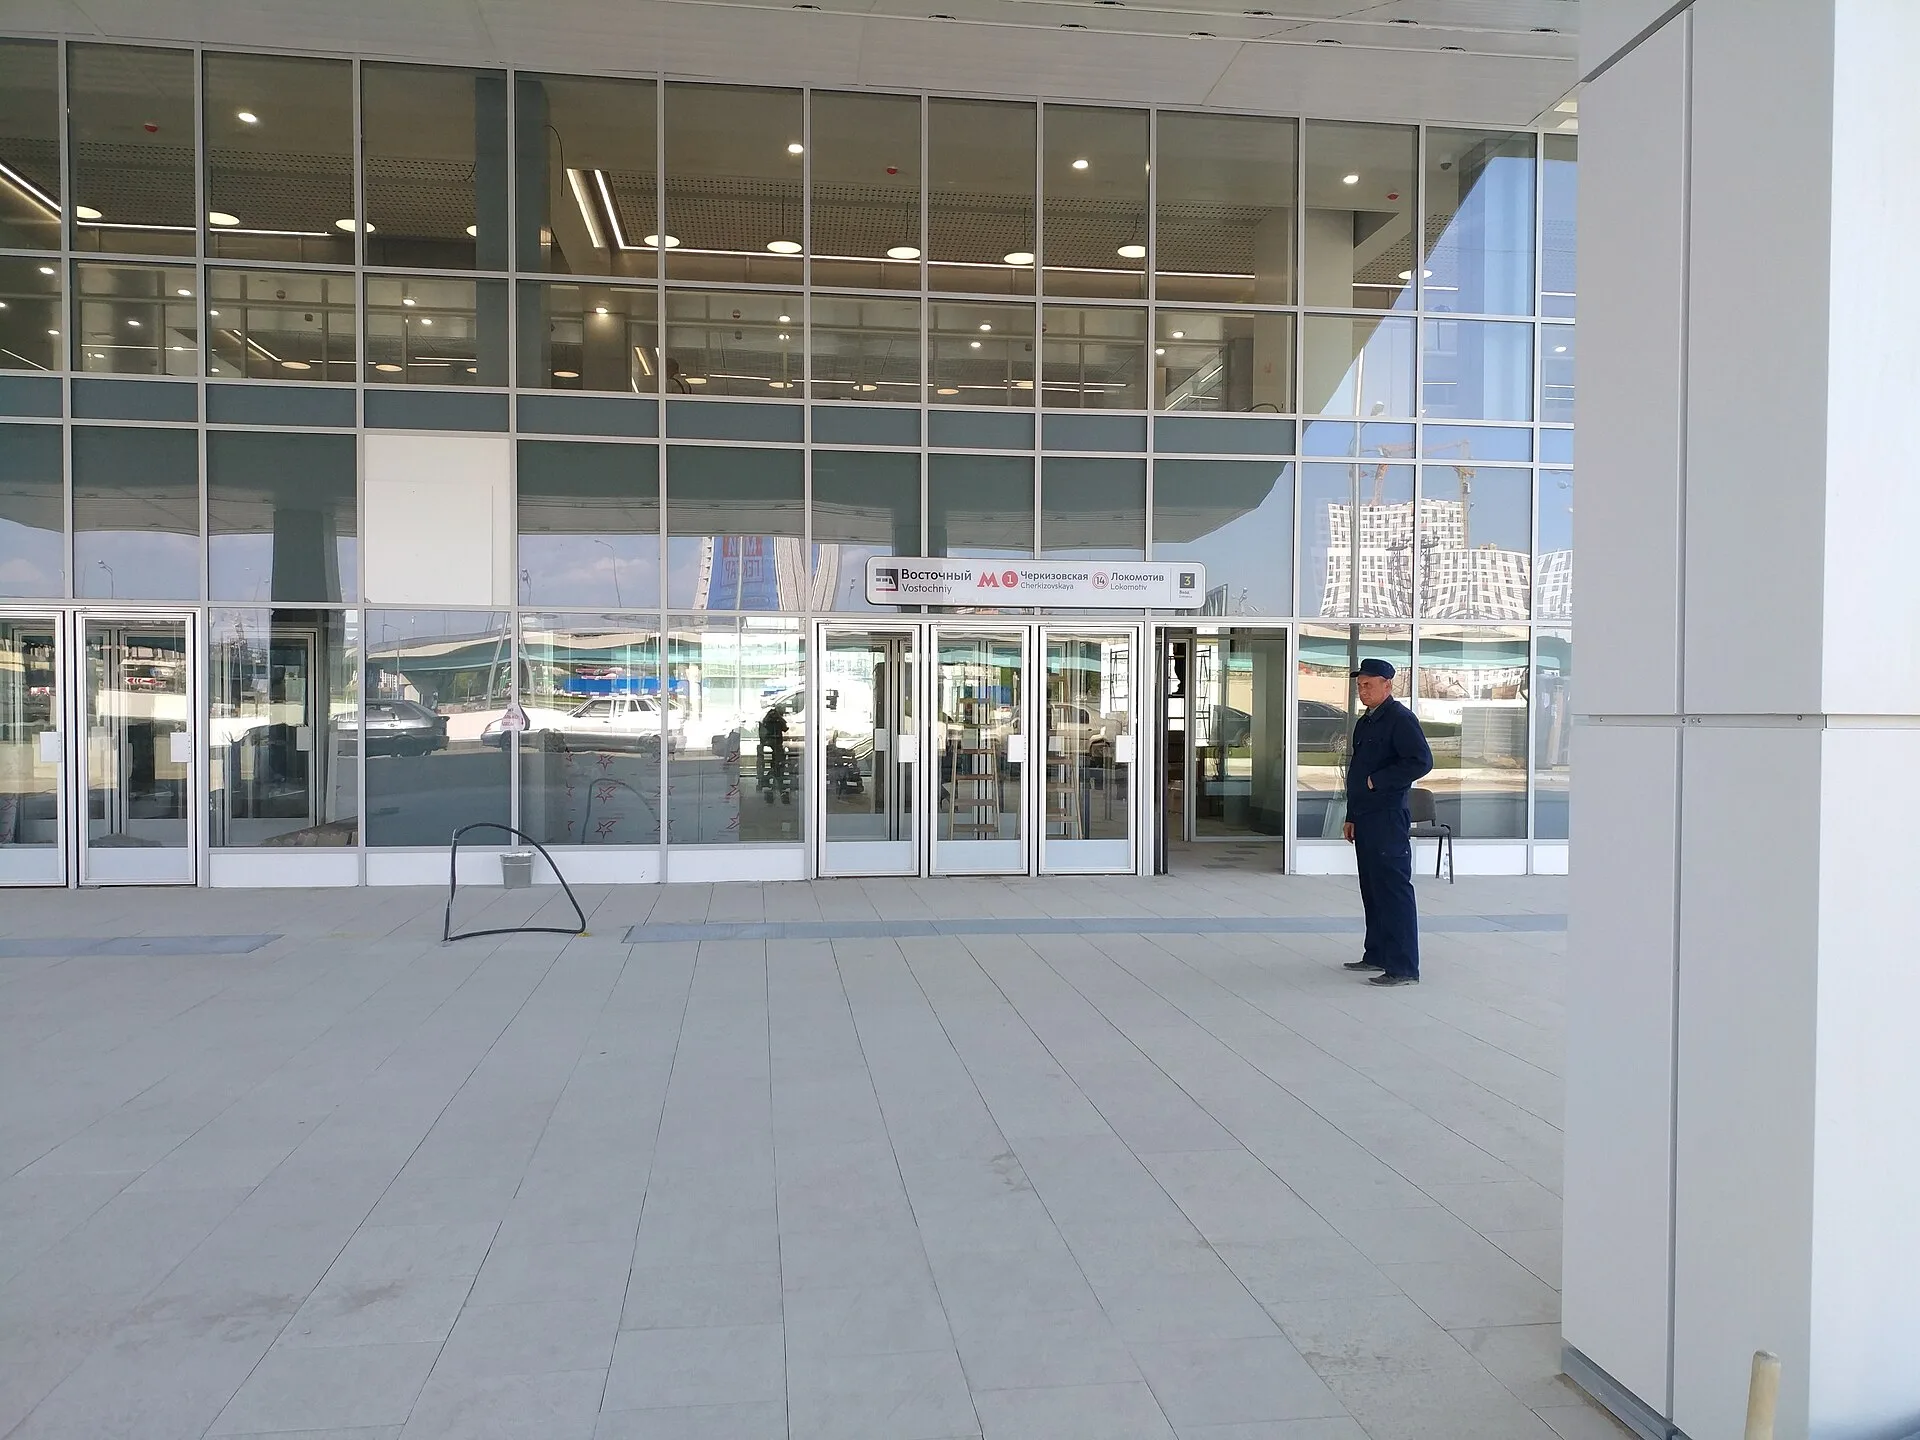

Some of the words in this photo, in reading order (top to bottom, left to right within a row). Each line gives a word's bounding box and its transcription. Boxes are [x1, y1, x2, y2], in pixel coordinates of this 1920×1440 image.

[901, 568, 972, 581] Восточный
[1020, 570, 1089, 581] Черкизовская
[1110, 572, 1164, 582] Локомотив
[1095, 576, 1106, 585] 14
[1183, 576, 1191, 586] 3
[901, 583, 952, 595] Vostochniy
[1020, 582, 1074, 591] Cherkizovskaya
[1110, 583, 1148, 591] Lokomotiv
